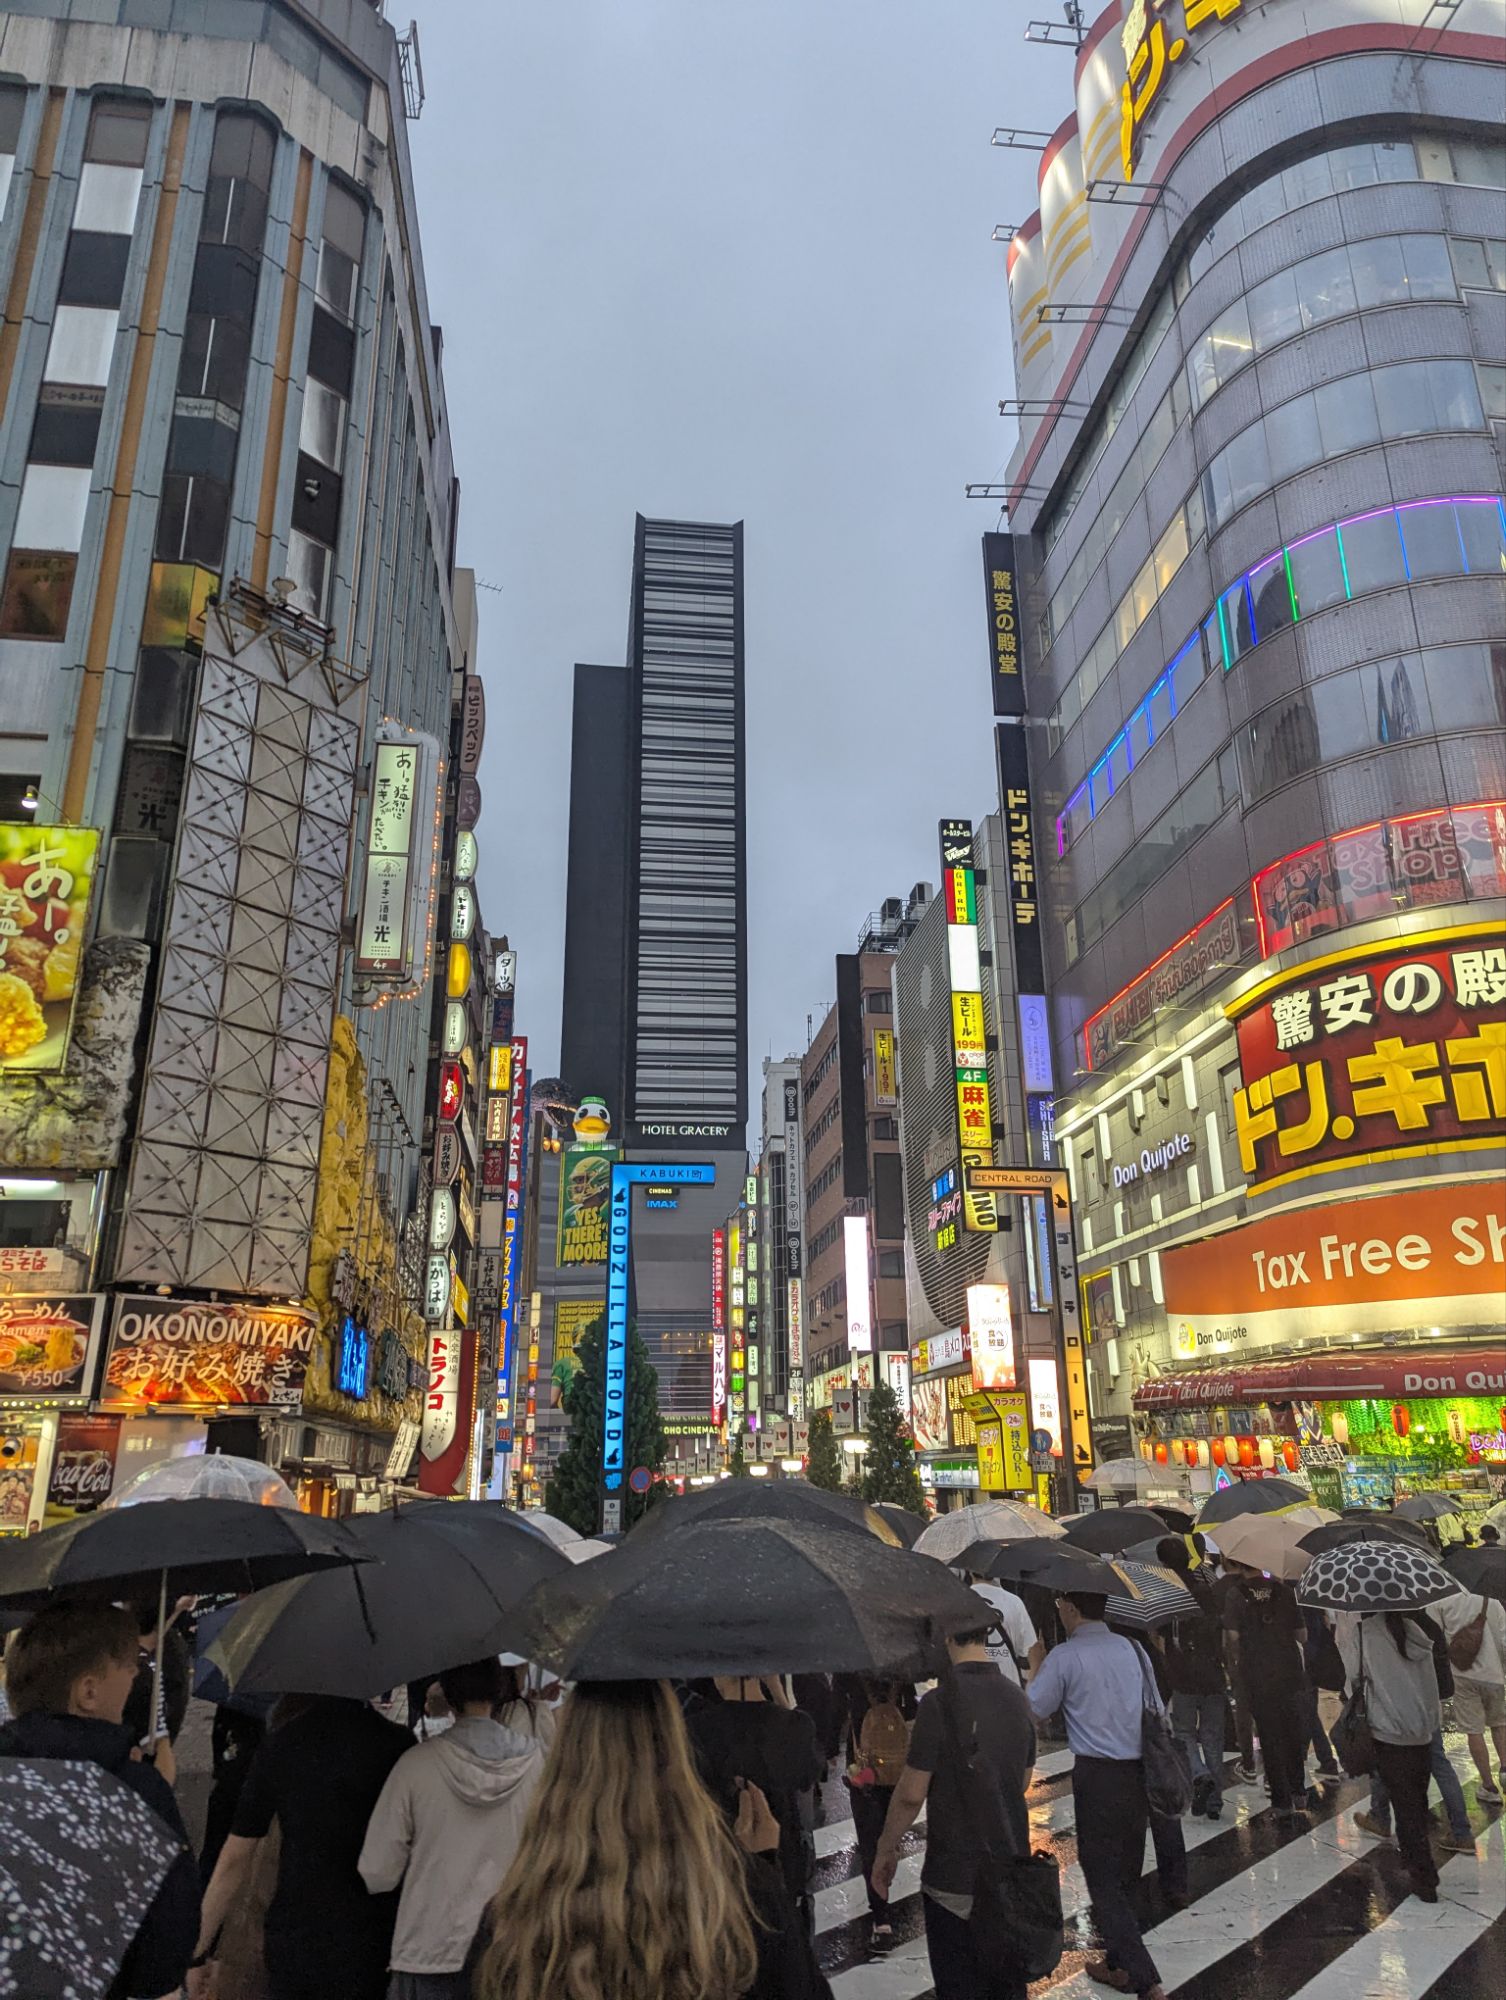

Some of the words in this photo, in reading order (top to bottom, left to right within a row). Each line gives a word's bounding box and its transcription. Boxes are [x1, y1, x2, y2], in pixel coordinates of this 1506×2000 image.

[992, 570, 1018, 675] 驚安の殿堂
[1400, 816, 1494, 850] Free
[1008, 789, 1035, 923] ドン・キホーテ
[21, 838, 74, 945] あー。
[374, 925, 390, 943] 光
[373, 959, 387, 970] 4F
[500, 958, 511, 983] ダーツ
[960, 996, 972, 1037] 生ビール
[879, 1033, 888, 1064] 生ビール
[956, 1040, 983, 1049] 199円
[963, 1071, 982, 1082] 4F
[962, 1086, 986, 1127] 麻雀
[642, 1125, 677, 1135] HOTEL
[679, 1125, 729, 1136] GRACERY
[1039, 1101, 1051, 1161] SHISHA
[1113, 1159, 1138, 1189] Don
[1140, 1131, 1190, 1174] Quijote
[974, 1174, 1021, 1183] CENTRAL
[1024, 1175, 1052, 1183] ROAD
[575, 1206, 602, 1225] YES,
[565, 1222, 608, 1244] THERE'
[563, 1243, 608, 1262] MOORE
[788, 1237, 800, 1270] Booth
[1252, 1250, 1311, 1292] Tax
[1320, 1234, 1432, 1281] Free
[430, 1268, 443, 1303] かっぱ
[609, 1207, 627, 1351] GODZILLA
[428, 1307, 440, 1315] B1
[118, 1312, 317, 1352] OKONOMIYAKI
[1196, 1331, 1213, 1346] Don
[1215, 1325, 1247, 1343] Quijote
[124, 1347, 294, 1389] お好み焼き
[428, 1337, 447, 1409] トラノコ
[713, 1346, 724, 1404] マルハン
[1405, 1374, 1456, 1391] Don
[606, 1369, 623, 1441] ROAD
[993, 1397, 1024, 1406] カラオケ
[1200, 1383, 1234, 1398] Quijote
